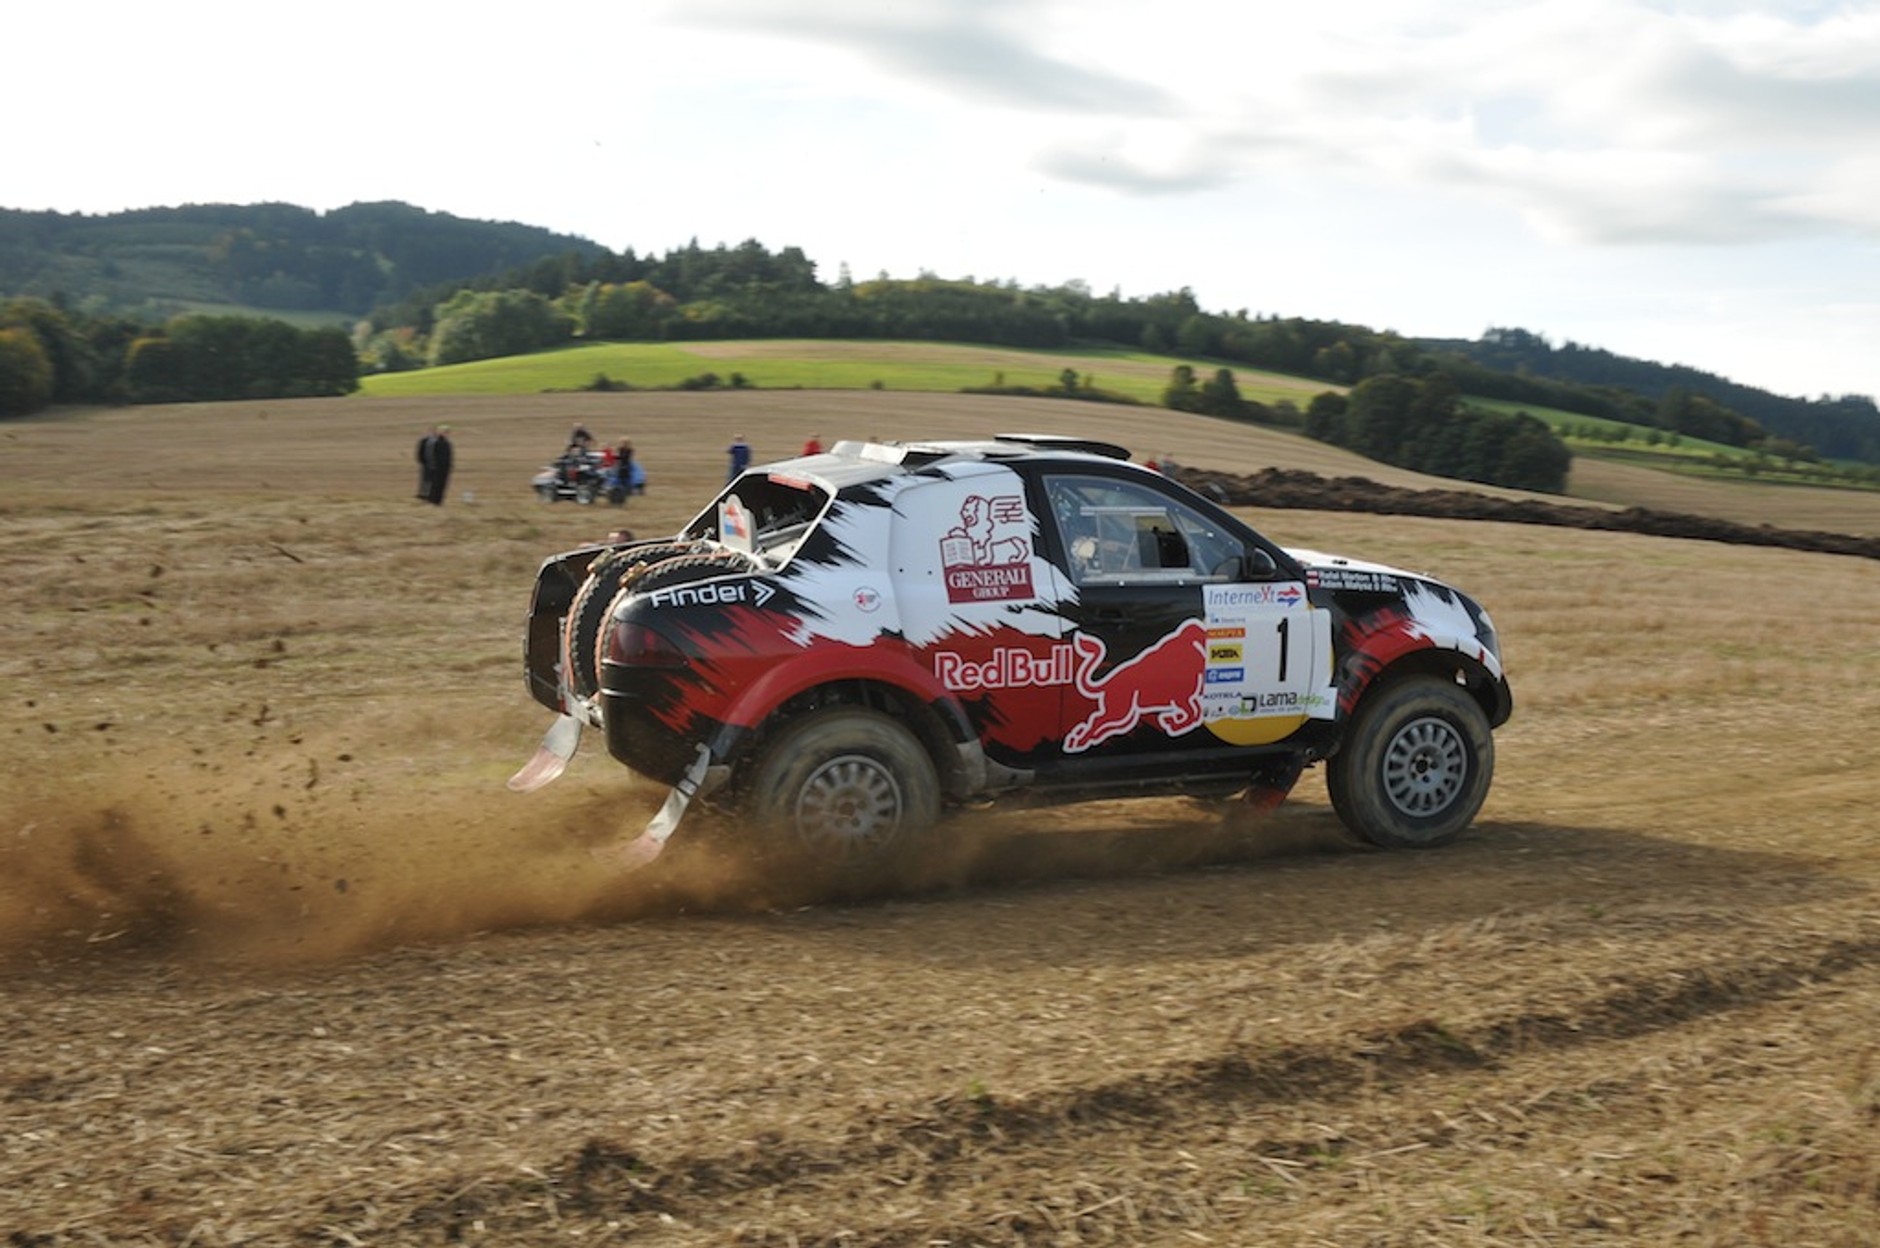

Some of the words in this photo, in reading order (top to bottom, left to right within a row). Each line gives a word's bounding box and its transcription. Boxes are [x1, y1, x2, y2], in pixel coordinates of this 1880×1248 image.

[948, 569, 1028, 588] GENERALI
[650, 584, 746, 608] Finder
[972, 587, 1010, 598] GROUP
[1277, 617, 1289, 682] 1
[935, 647, 1005, 690] Red
[1007, 644, 1073, 687] Bull
